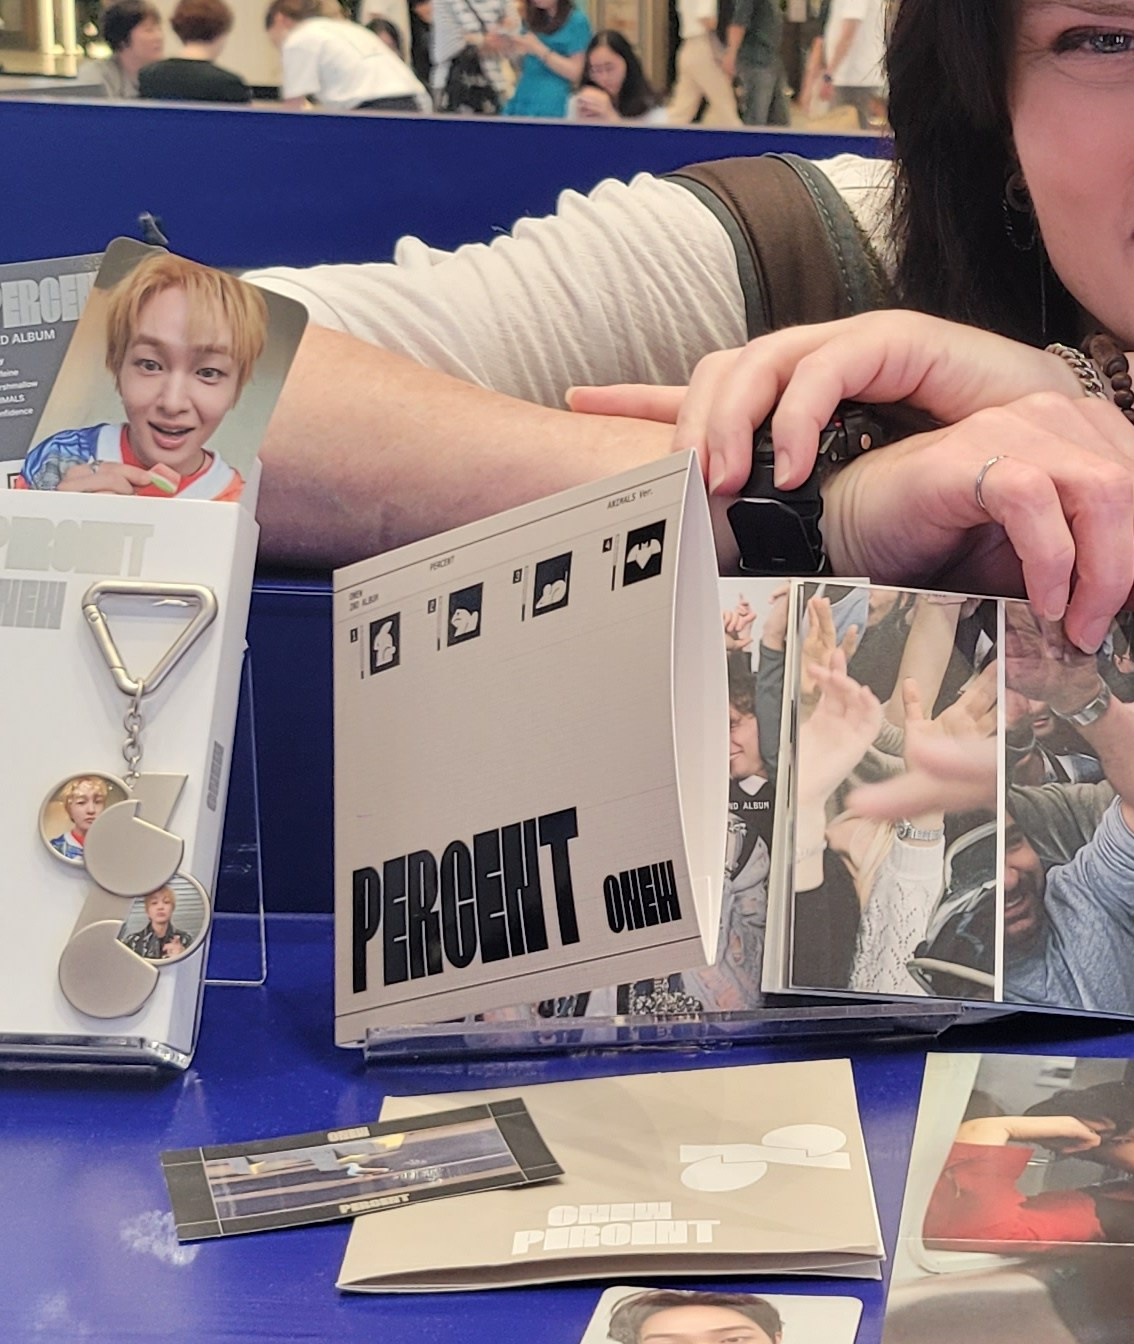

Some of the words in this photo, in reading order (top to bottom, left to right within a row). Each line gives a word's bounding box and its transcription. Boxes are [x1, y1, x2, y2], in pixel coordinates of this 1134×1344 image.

[0, 270, 99, 328] ERCE
[12, 329, 55, 344] ALBUM
[0, 579, 67, 630] NEW
[743, 801, 769, 810] ALBUM
[352, 806, 580, 994] PERCENT
[603, 859, 682, 933] ONEW
